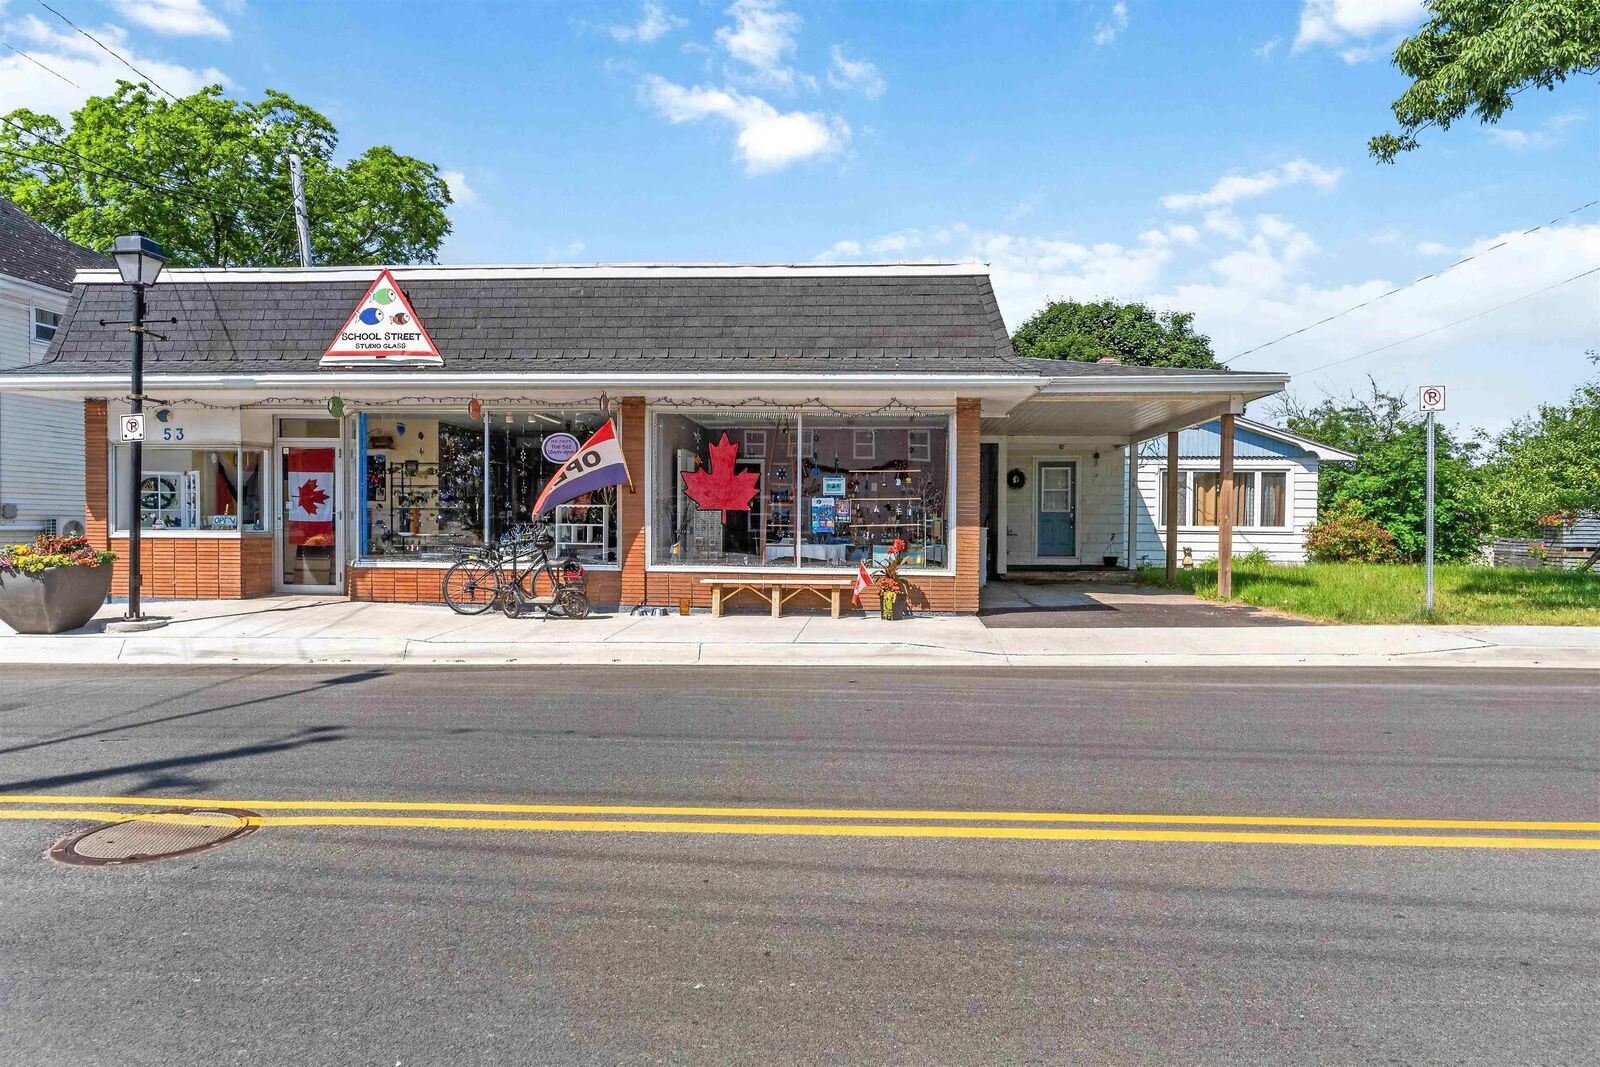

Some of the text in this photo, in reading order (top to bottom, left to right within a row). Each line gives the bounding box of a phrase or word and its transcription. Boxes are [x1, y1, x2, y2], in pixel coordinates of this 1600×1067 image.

[341, 332, 422, 341] SCHOOL STREET
[1428, 391, 1437, 403] P
[213, 516, 236, 525] OPEN
